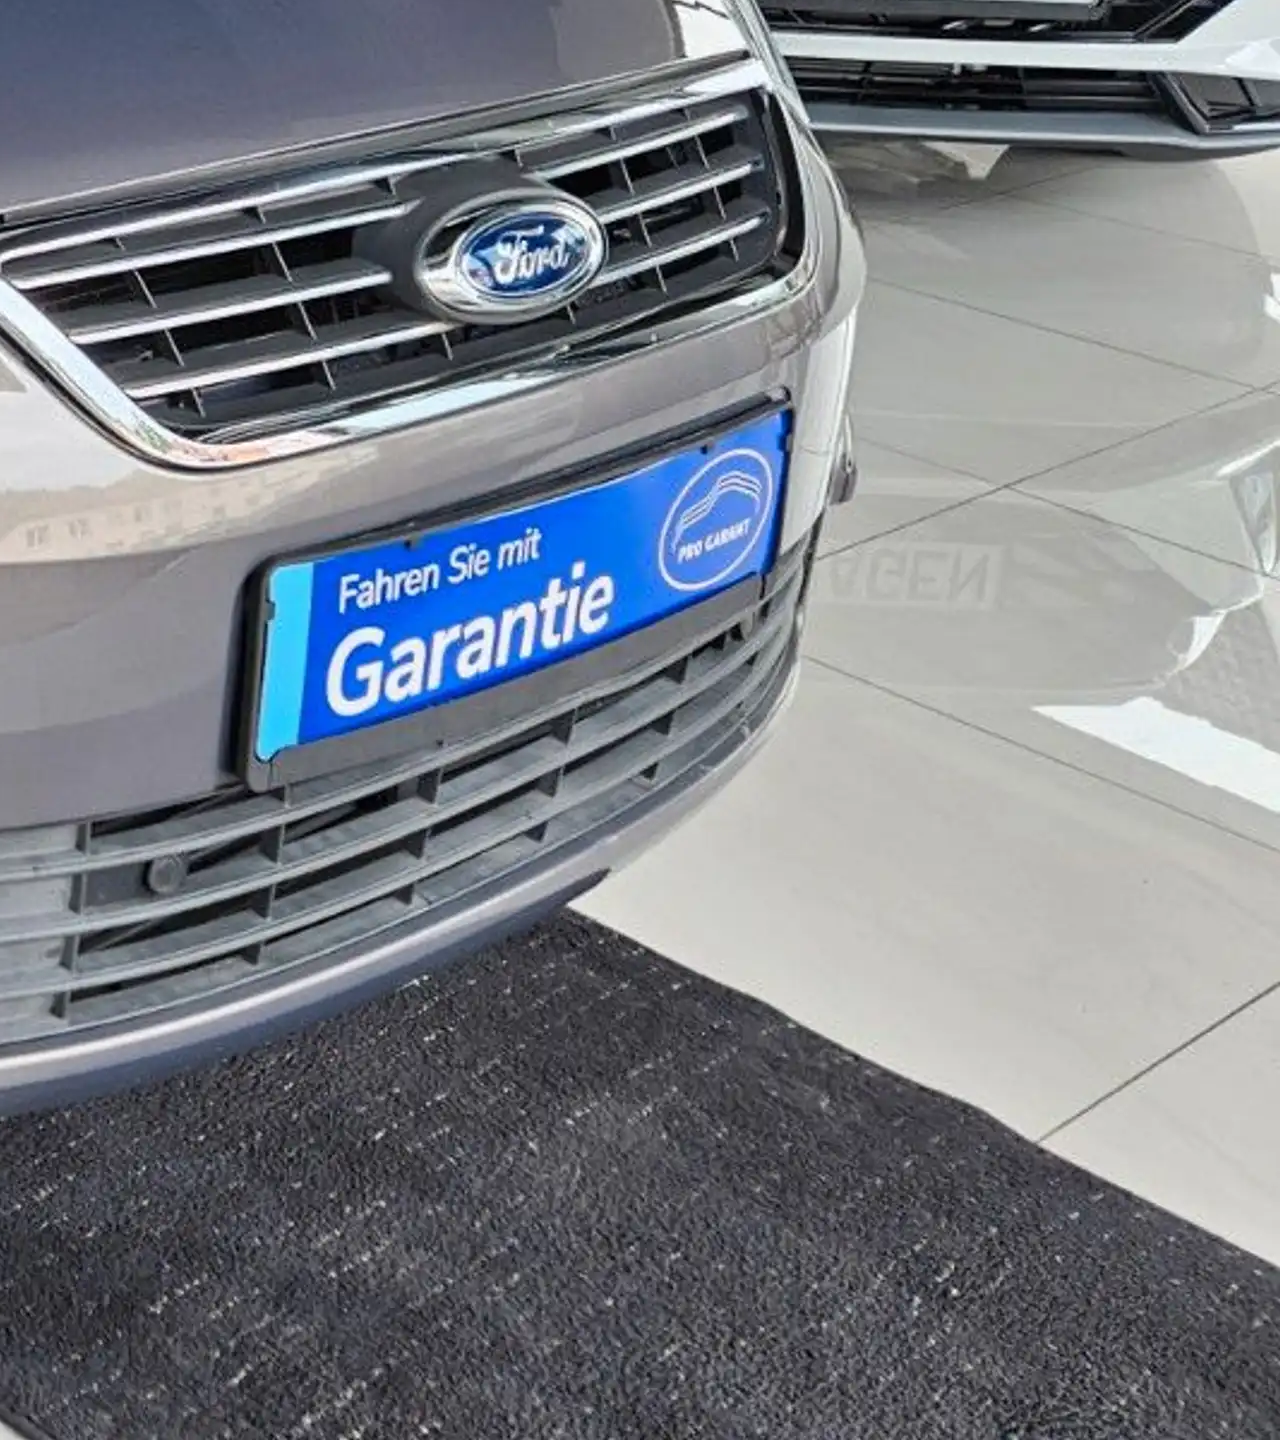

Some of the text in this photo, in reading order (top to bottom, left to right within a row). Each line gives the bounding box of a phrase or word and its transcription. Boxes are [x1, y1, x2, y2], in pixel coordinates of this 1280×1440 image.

[492, 225, 572, 285] Ford
[339, 527, 542, 614] Fahren Sie mit
[326, 561, 615, 717] Garantie
